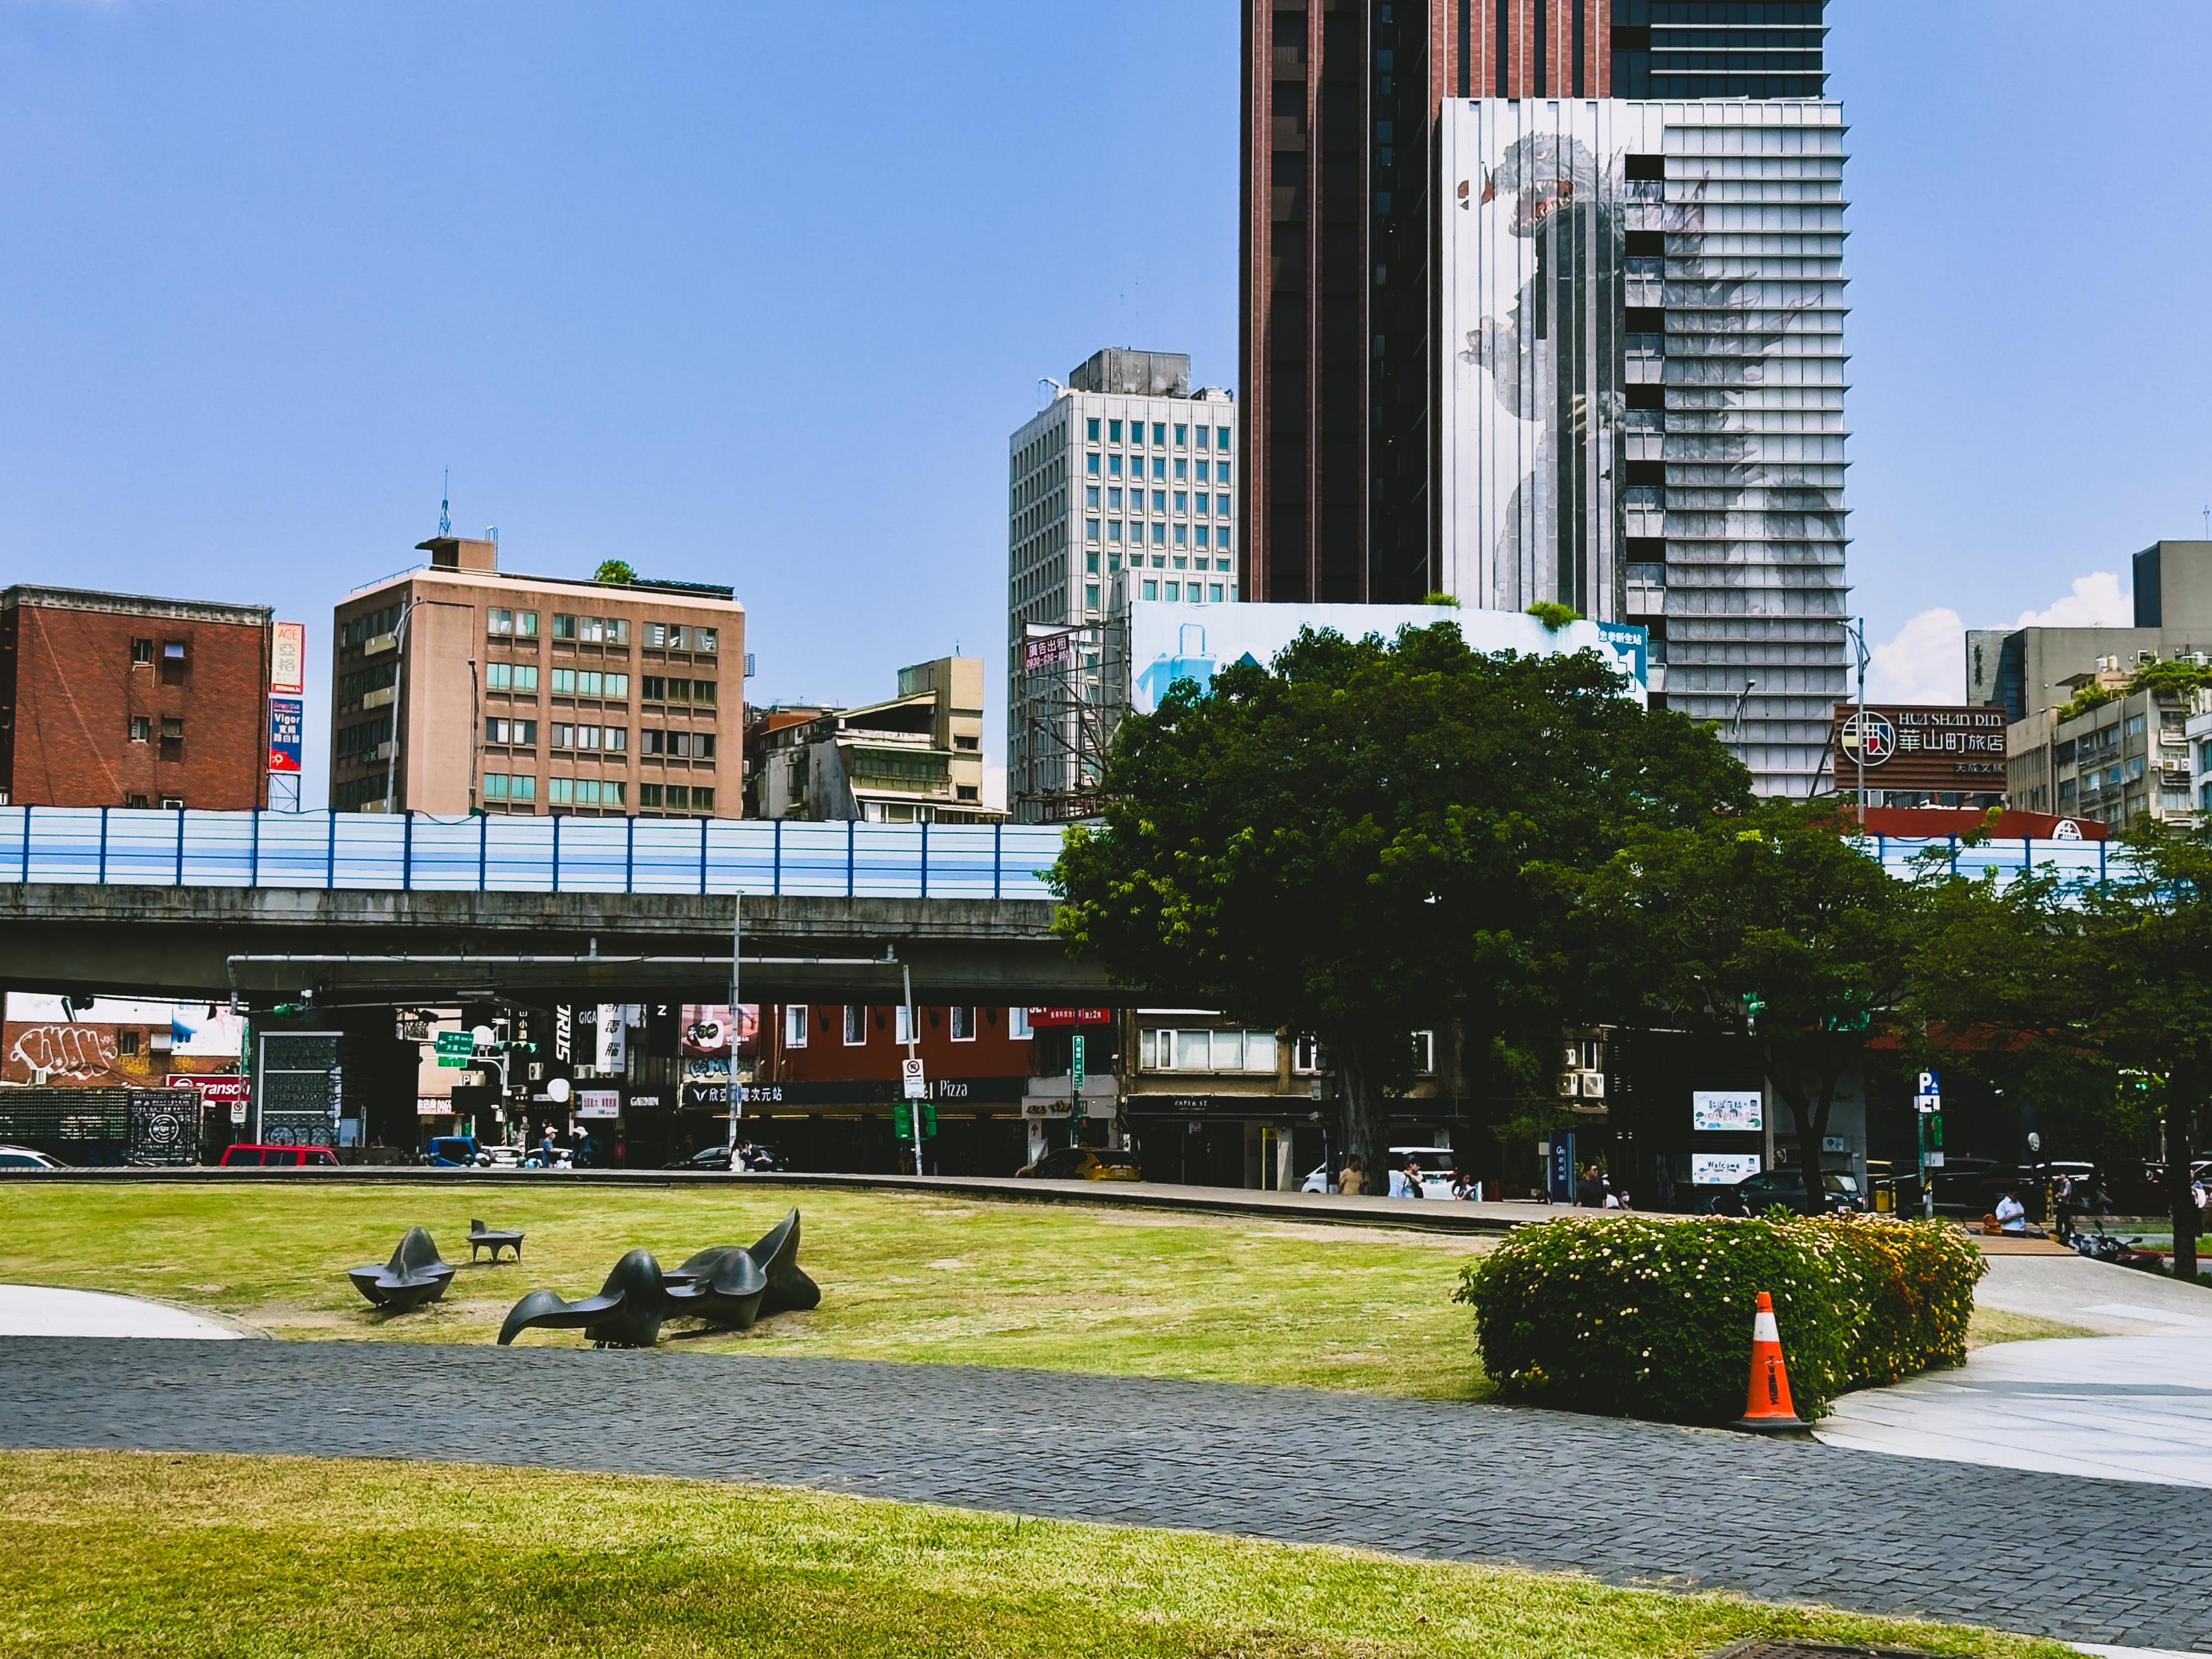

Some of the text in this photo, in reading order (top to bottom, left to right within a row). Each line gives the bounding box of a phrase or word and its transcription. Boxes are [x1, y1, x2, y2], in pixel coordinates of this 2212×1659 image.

[278, 629, 298, 640] ACE
[1029, 637, 1066, 658] 廣告出租
[274, 713, 301, 725] Vigor
[1899, 712, 1928, 726] HUA
[1931, 713, 1971, 726] SHAN
[1899, 728, 2004, 754] 華山町旅店
[196, 1082, 251, 1095] ransc
[940, 1080, 968, 1097] Pizza
[1919, 1072, 1932, 1094] P
